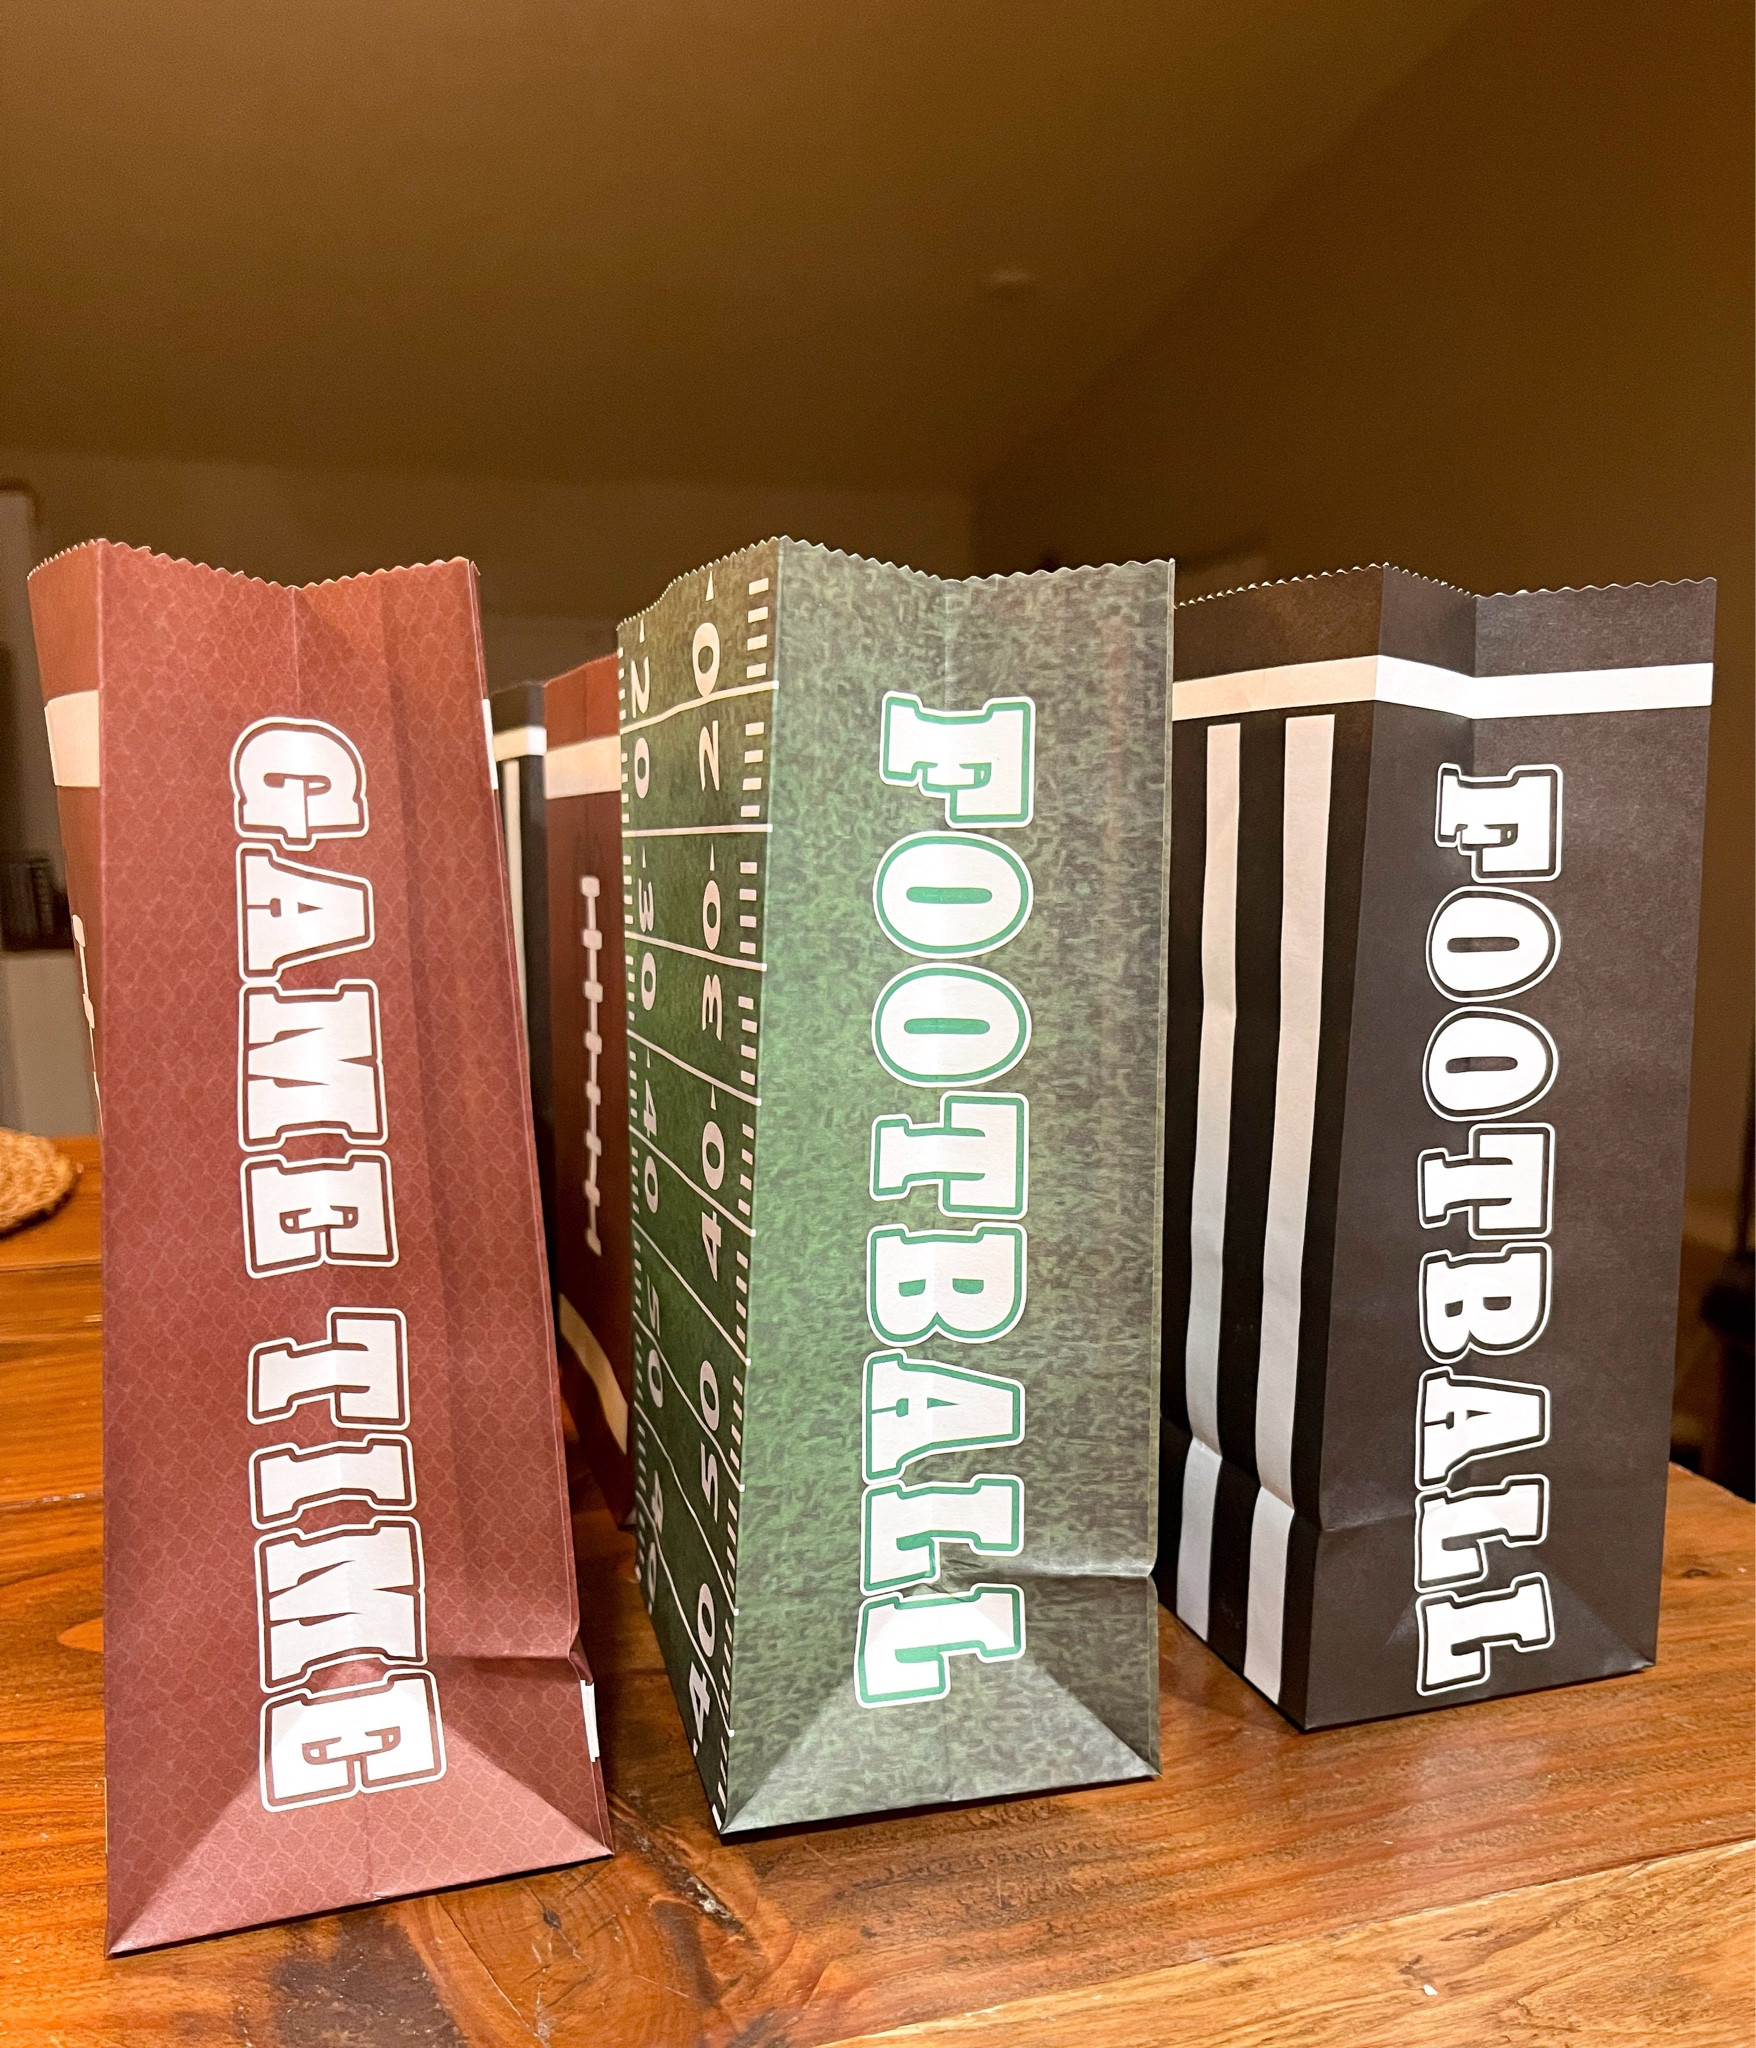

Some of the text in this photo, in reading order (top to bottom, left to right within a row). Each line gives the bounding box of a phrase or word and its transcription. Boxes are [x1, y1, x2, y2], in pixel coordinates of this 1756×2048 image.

[692, 622, 720, 791] 20
[702, 880, 722, 1041] 30
[231, 716, 447, 1812] GAME TIME
[701, 1120, 725, 1282] 40
[853, 691, 1036, 1709] FOOTBALL
[1415, 763, 1564, 1697] FOOTBALL
[699, 1360, 719, 1524] 50
[689, 1583, 715, 1743] 40
